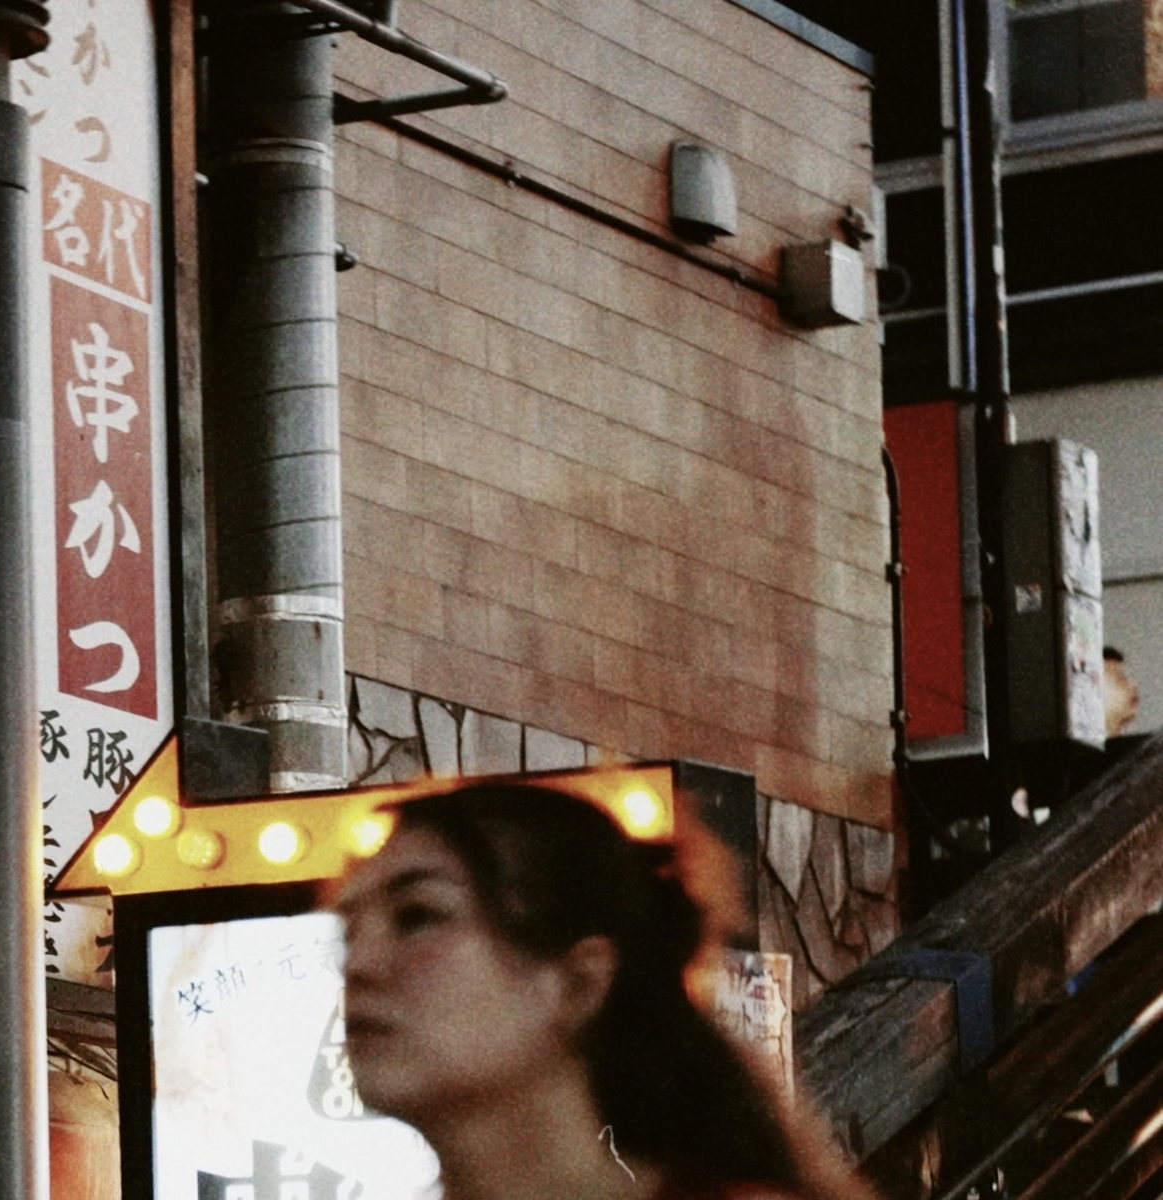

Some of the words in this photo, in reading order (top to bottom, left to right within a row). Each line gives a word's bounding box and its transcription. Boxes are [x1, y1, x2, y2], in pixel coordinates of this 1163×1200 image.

[71, 0, 112, 163] かつ
[43, 173, 148, 300] 名代
[65, 322, 141, 693] 串かつ
